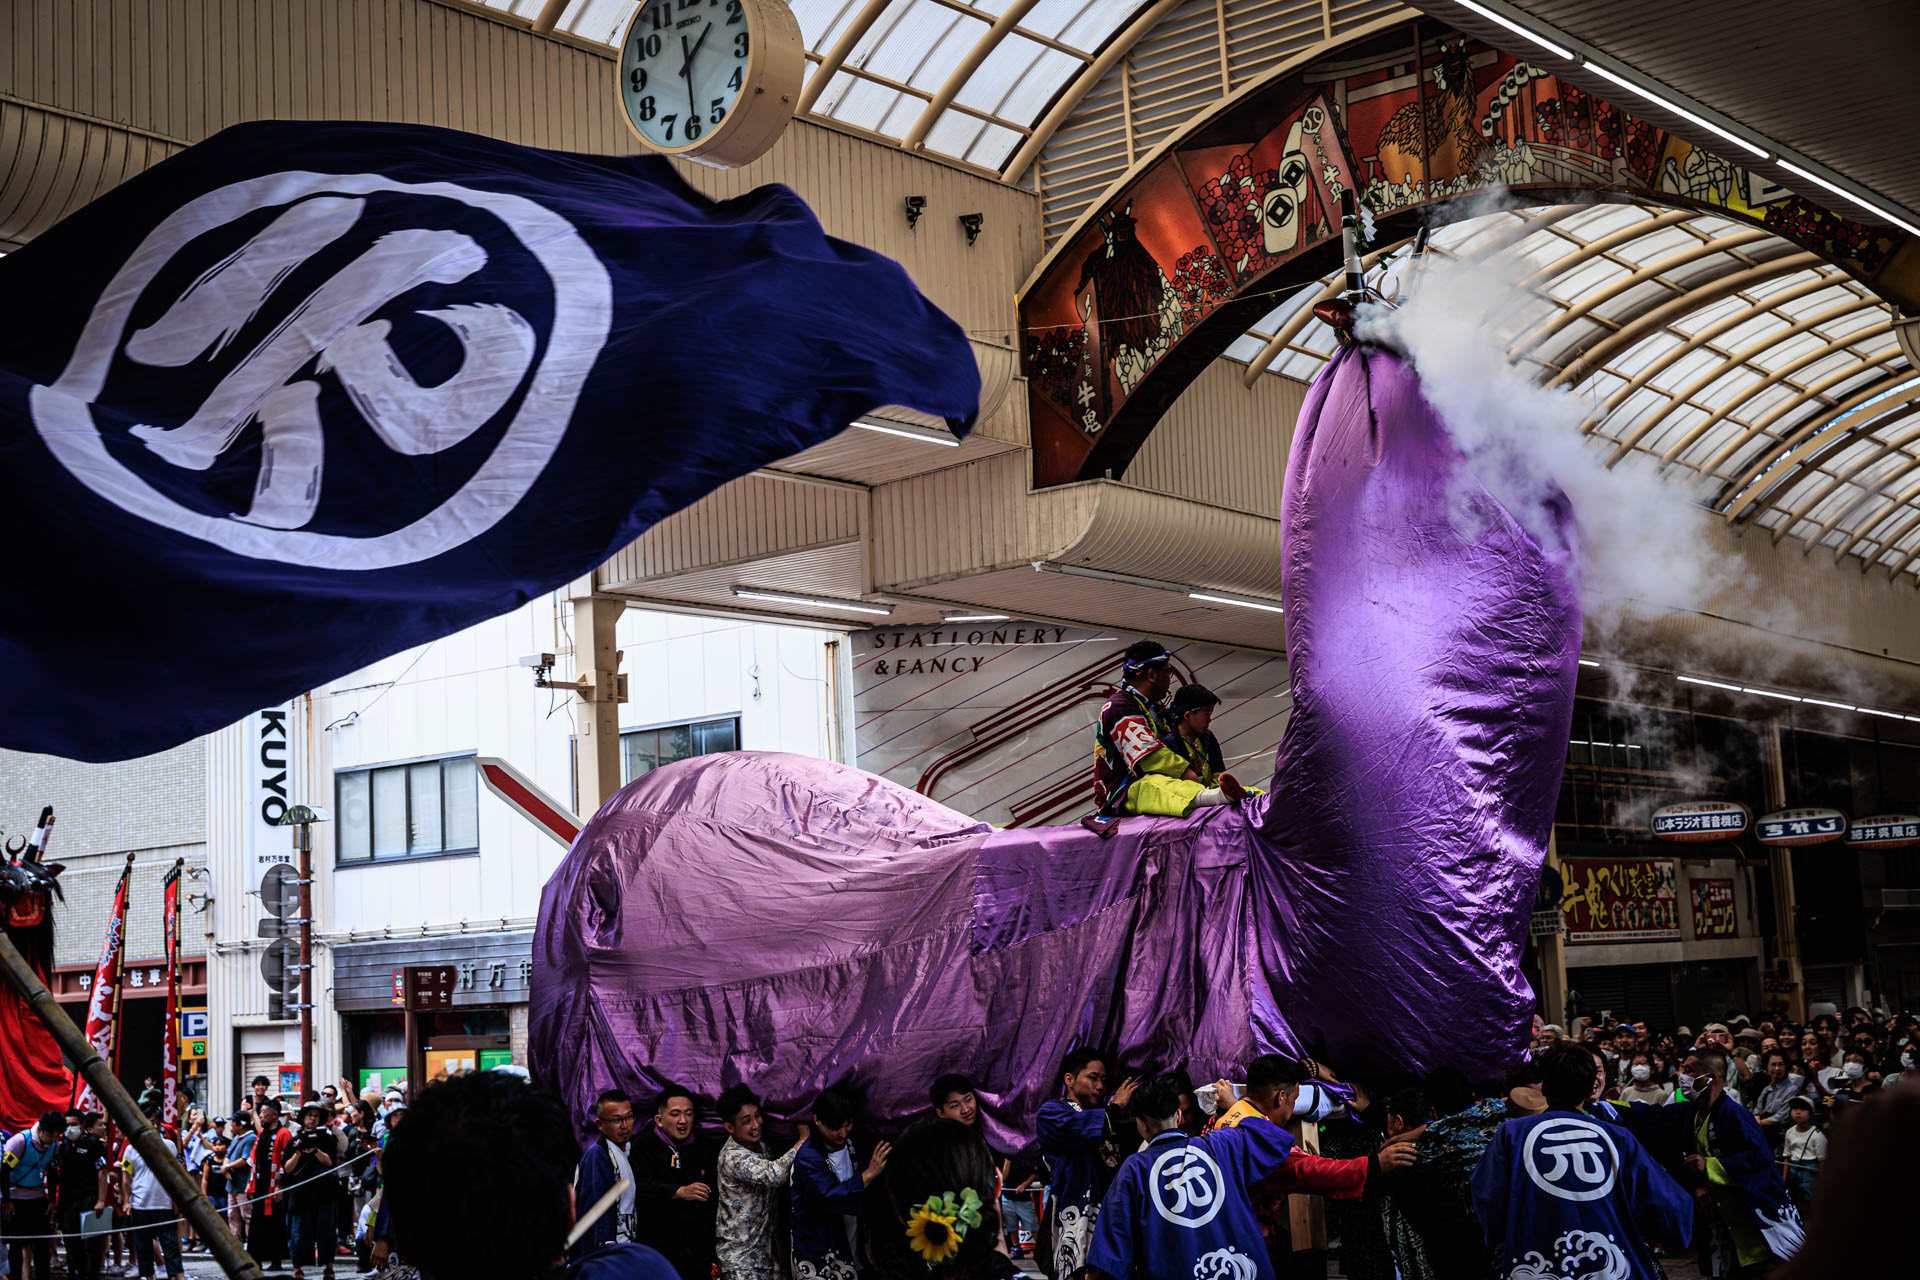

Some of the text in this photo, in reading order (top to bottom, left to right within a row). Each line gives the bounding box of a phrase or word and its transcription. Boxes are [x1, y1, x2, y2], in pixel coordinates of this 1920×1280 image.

[652, 3, 672, 31] 11
[676, 15, 701, 30] SEIKO
[637, 33, 661, 62] 10
[734, 32, 748, 58] 3
[630, 67, 647, 93] 9
[727, 66, 743, 92] 4
[639, 95, 656, 122] 8
[710, 97, 726, 124] 5
[661, 113, 678, 141] 7
[684, 115, 702, 140] 6
[1077, 380, 1102, 433] 牛鬼
[874, 628, 1067, 649] STATIONERY
[874, 657, 985, 676] &FANCY
[261, 711, 287, 827] KUYO
[1655, 814, 1743, 831] 山本ラジオ蓄音機店
[188, 1014, 208, 1036] P
[1541, 1128, 1606, 1184] 元
